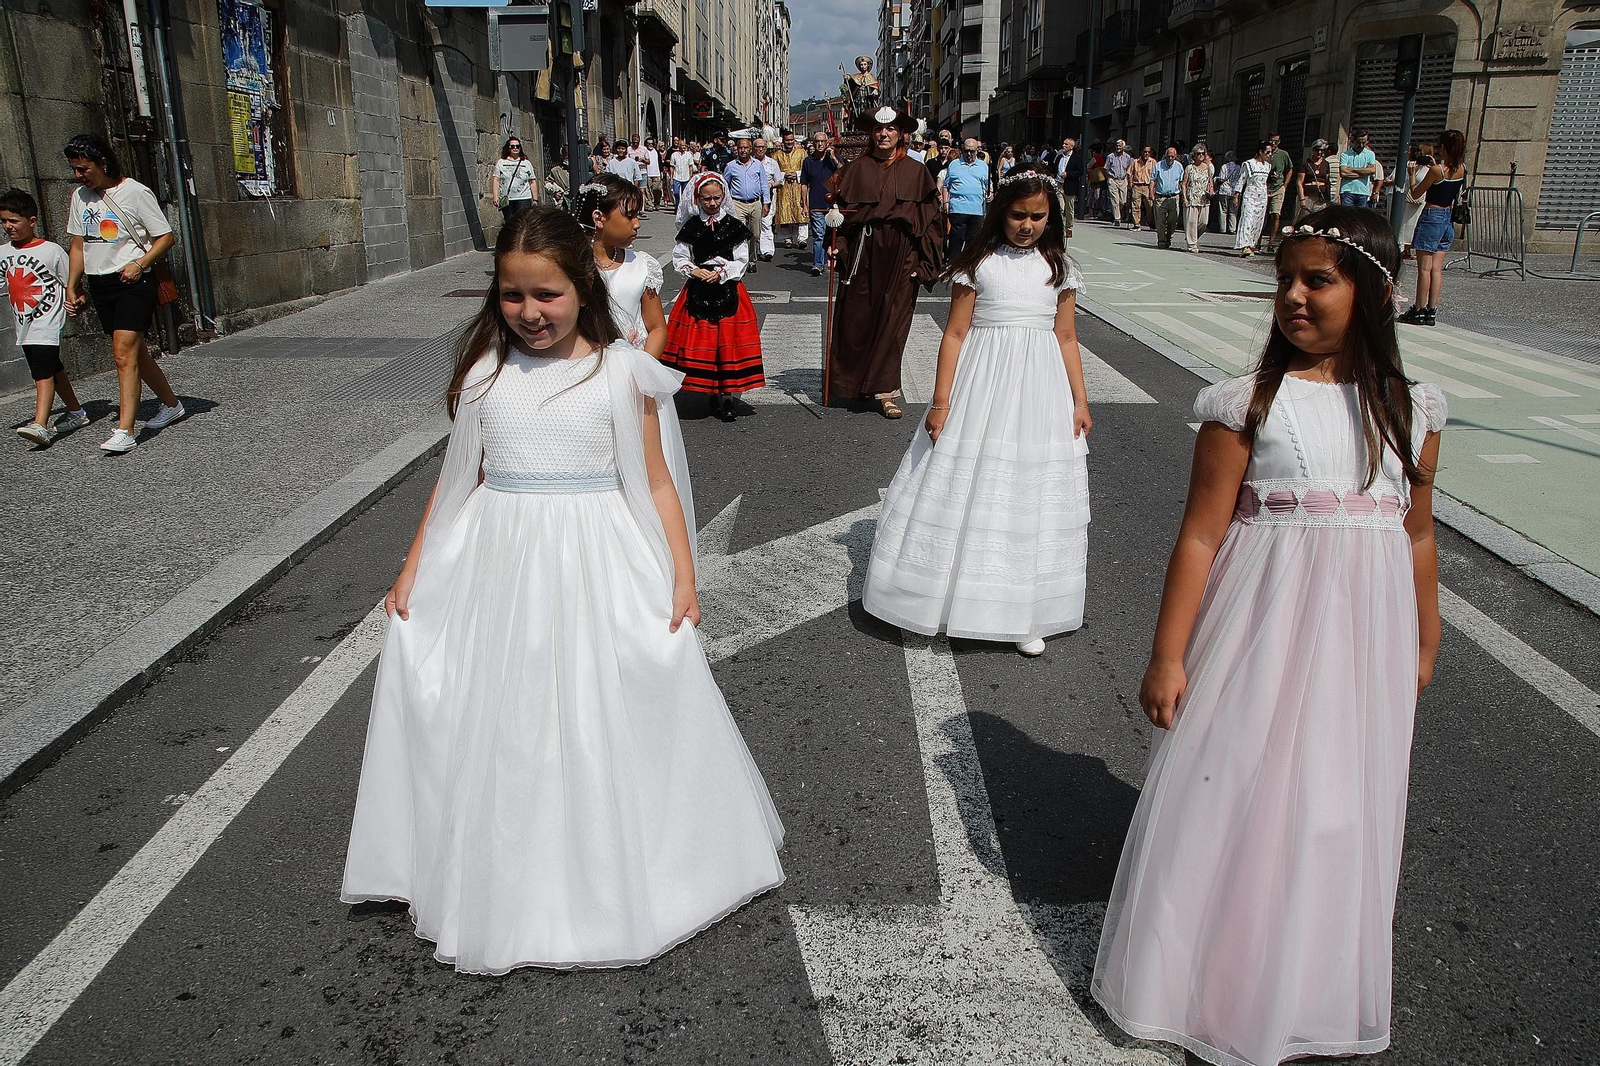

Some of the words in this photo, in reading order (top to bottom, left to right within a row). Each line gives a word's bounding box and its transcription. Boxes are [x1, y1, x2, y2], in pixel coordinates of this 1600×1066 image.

[1503, 38, 1542, 47] AVENIDA
[1498, 51, 1544, 59] SANTIAGO
[17, 254, 57, 284] CHILI
[14, 281, 57, 325] PEPPER
